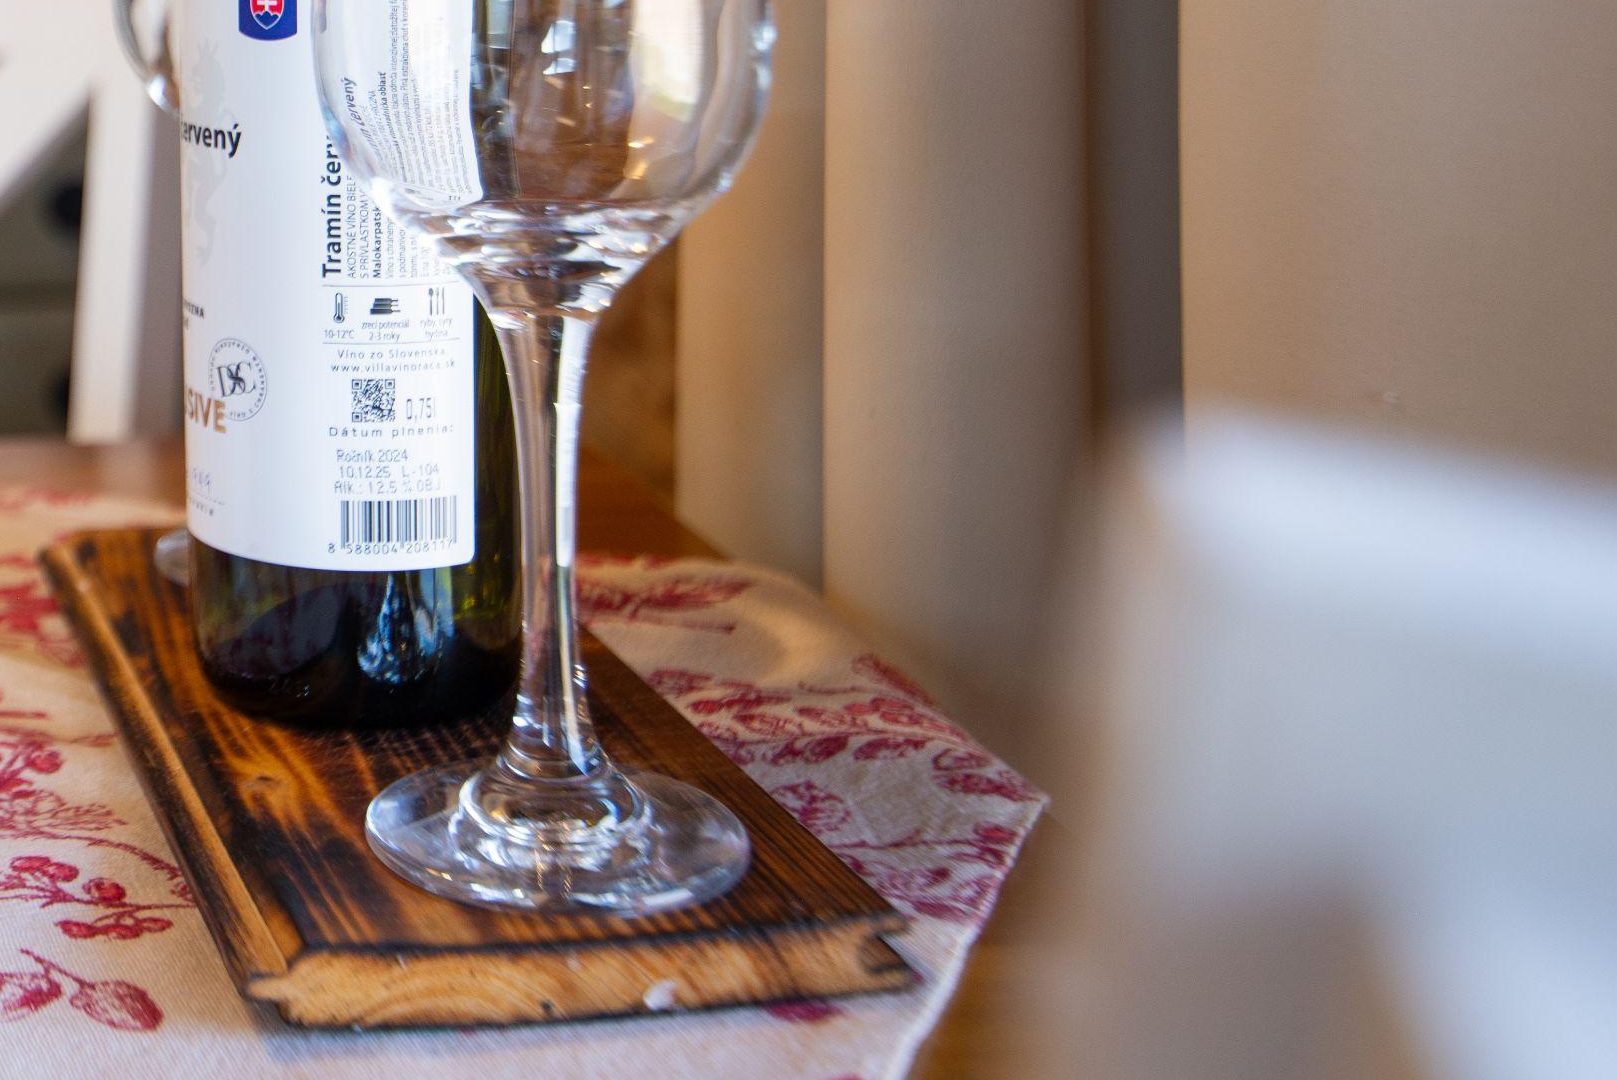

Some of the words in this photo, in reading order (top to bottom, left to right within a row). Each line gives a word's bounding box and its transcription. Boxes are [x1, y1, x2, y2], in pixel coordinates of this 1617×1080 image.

[320, 193, 342, 279] Tramín
[329, 425, 383, 438] Dátum
[378, 448, 409, 463] 2024
[327, 543, 336, 555] 8
[345, 542, 399, 556] 588004
